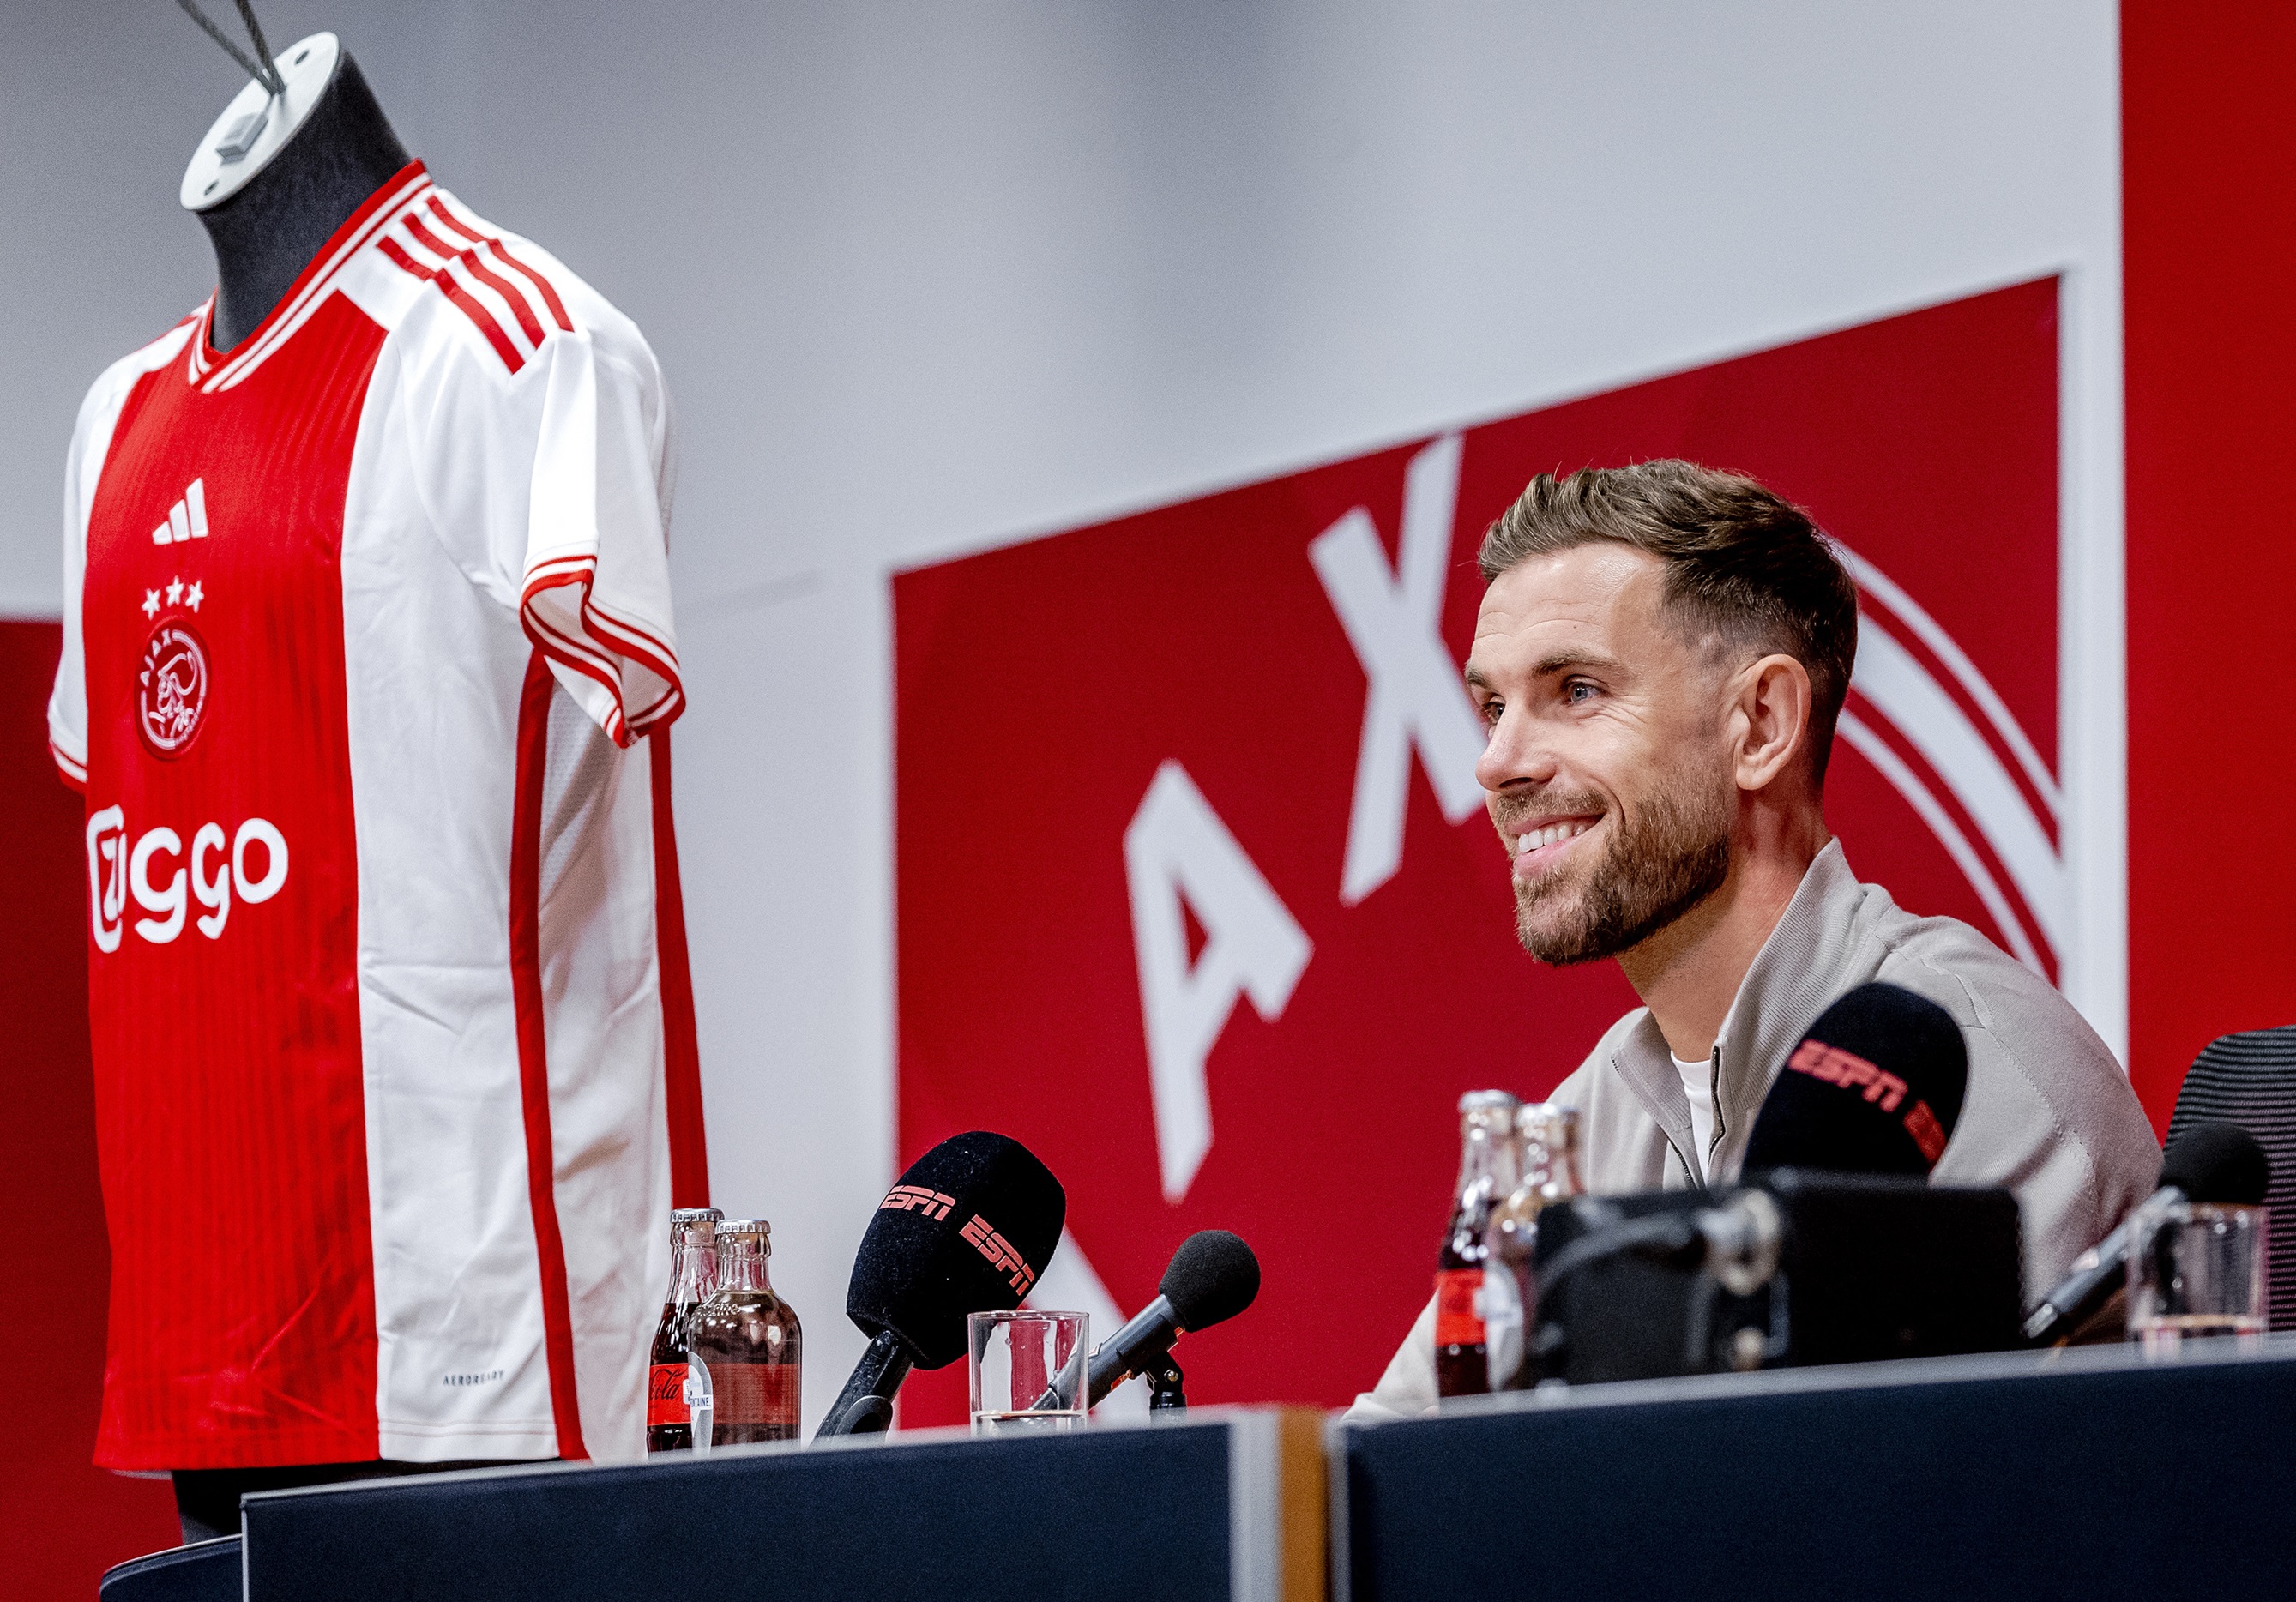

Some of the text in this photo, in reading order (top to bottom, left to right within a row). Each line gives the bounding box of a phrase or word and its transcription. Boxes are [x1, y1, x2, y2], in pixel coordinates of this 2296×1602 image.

[1787, 1038, 1909, 1113] ESPN
[879, 1185, 1035, 1297] ESPN ESPN
